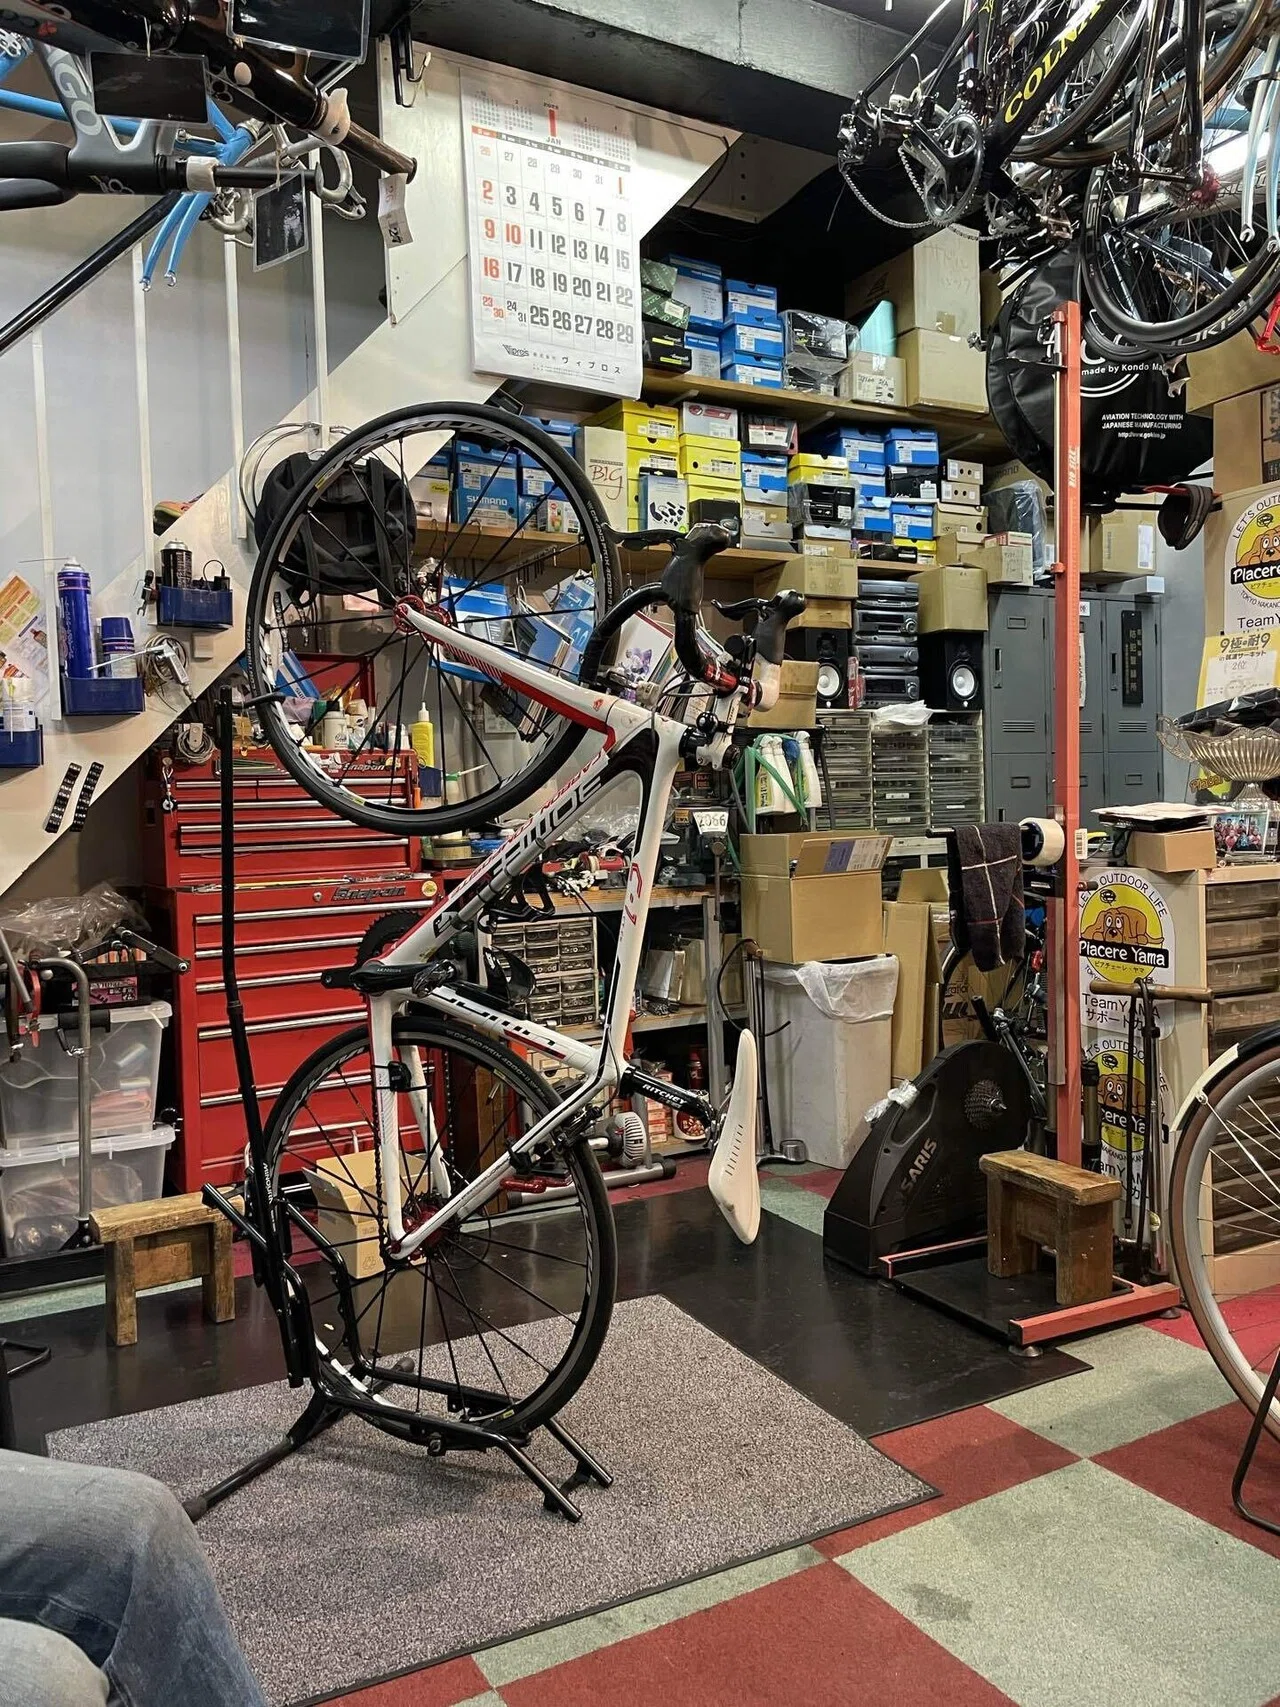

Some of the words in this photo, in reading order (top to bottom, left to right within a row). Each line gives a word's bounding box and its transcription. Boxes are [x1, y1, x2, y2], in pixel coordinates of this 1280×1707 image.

[482, 180, 493, 200] 2
[506, 186, 516, 205] 3
[529, 192, 540, 211] 4
[552, 197, 563, 216] 5
[575, 202, 584, 221] 6
[596, 208, 605, 226] 7
[617, 213, 626, 232] 8
[485, 219, 496, 239] 9
[505, 223, 522, 245] 10
[529, 229, 543, 250] 11
[552, 234, 566, 255] 12
[573, 239, 588, 260] 13
[595, 244, 609, 265] 14
[483, 257, 500, 278] 16
[616, 249, 629, 269] 15
[507, 262, 522, 283] 17
[530, 267, 545, 288] 18
[553, 272, 568, 293] 19
[573, 277, 591, 297] 20
[596, 282, 611, 303] 21
[616, 287, 633, 308] 22
[483, 296, 493, 307] 23
[506, 301, 517, 312] 24
[493, 307, 504, 318] 30
[518, 312, 527, 323] 31
[530, 305, 549, 327] 25
[552, 310, 571, 331] 26
[575, 316, 593, 336] 27
[596, 319, 614, 340] 28
[616, 323, 634, 344] 29
[1081, 367, 1106, 376] made
[1108, 365, 1119, 374] by
[1121, 363, 1150, 372] Kondo
[1101, 413, 1130, 421] AVIATION
[1131, 413, 1168, 421] TECHNOLOGY
[1101, 422, 1134, 430] JAPANESE
[1134, 422, 1182, 430] MANUFACTURING
[589, 464, 624, 500] BIG
[1233, 510, 1255, 539] LET'S
[1100, 873, 1148, 893] OUTDOOR
[1148, 891, 1168, 919] LIFE
[1131, 946, 1165, 966] Yama
[642, 1083, 688, 1104] RITCHEY
[900, 1137, 937, 1193] SARIS
[263, 1162, 274, 1205] MINOURA
